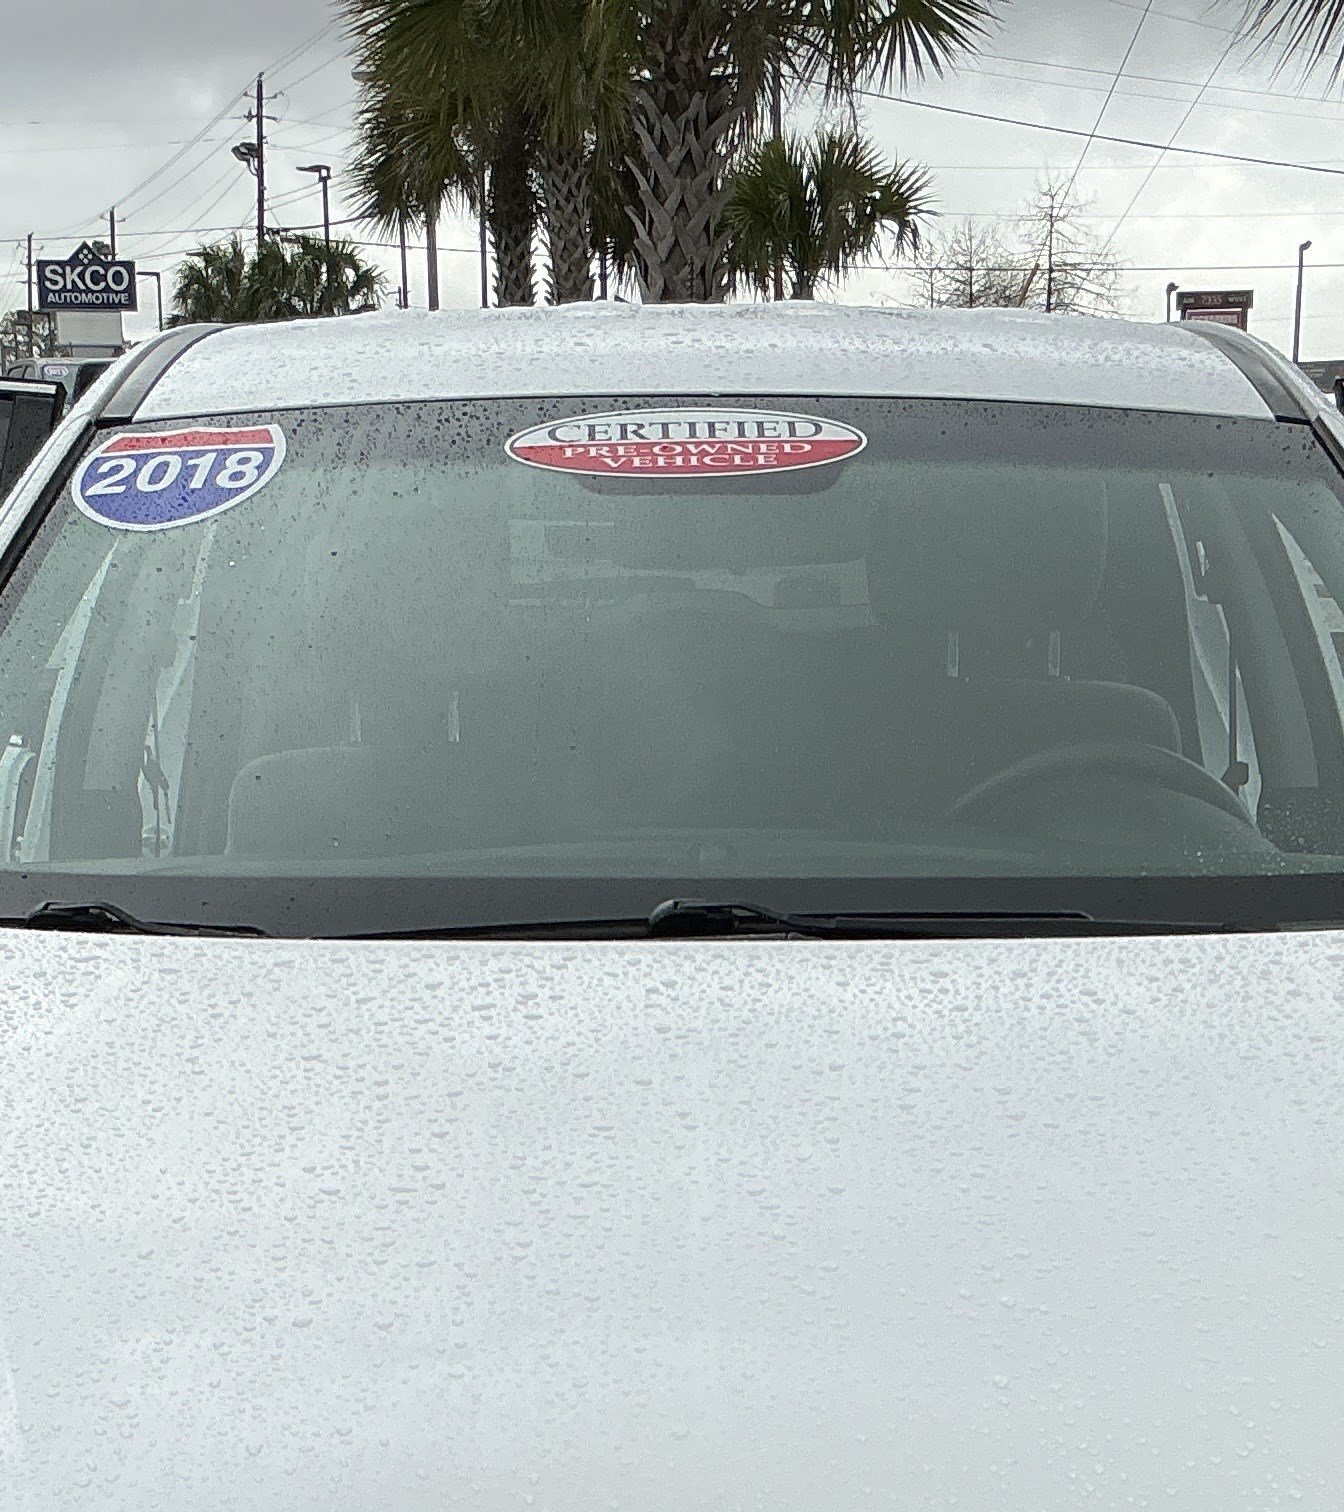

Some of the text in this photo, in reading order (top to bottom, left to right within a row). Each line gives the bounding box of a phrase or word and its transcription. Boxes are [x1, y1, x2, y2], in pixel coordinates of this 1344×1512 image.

[44, 264, 130, 292] SKCO
[47, 292, 130, 305] AUTOMOTIVE
[547, 420, 824, 443] CERTIFIED
[563, 442, 813, 459] PRE-OWNED
[601, 454, 778, 468] VEHICLE
[85, 451, 264, 497] 2018
